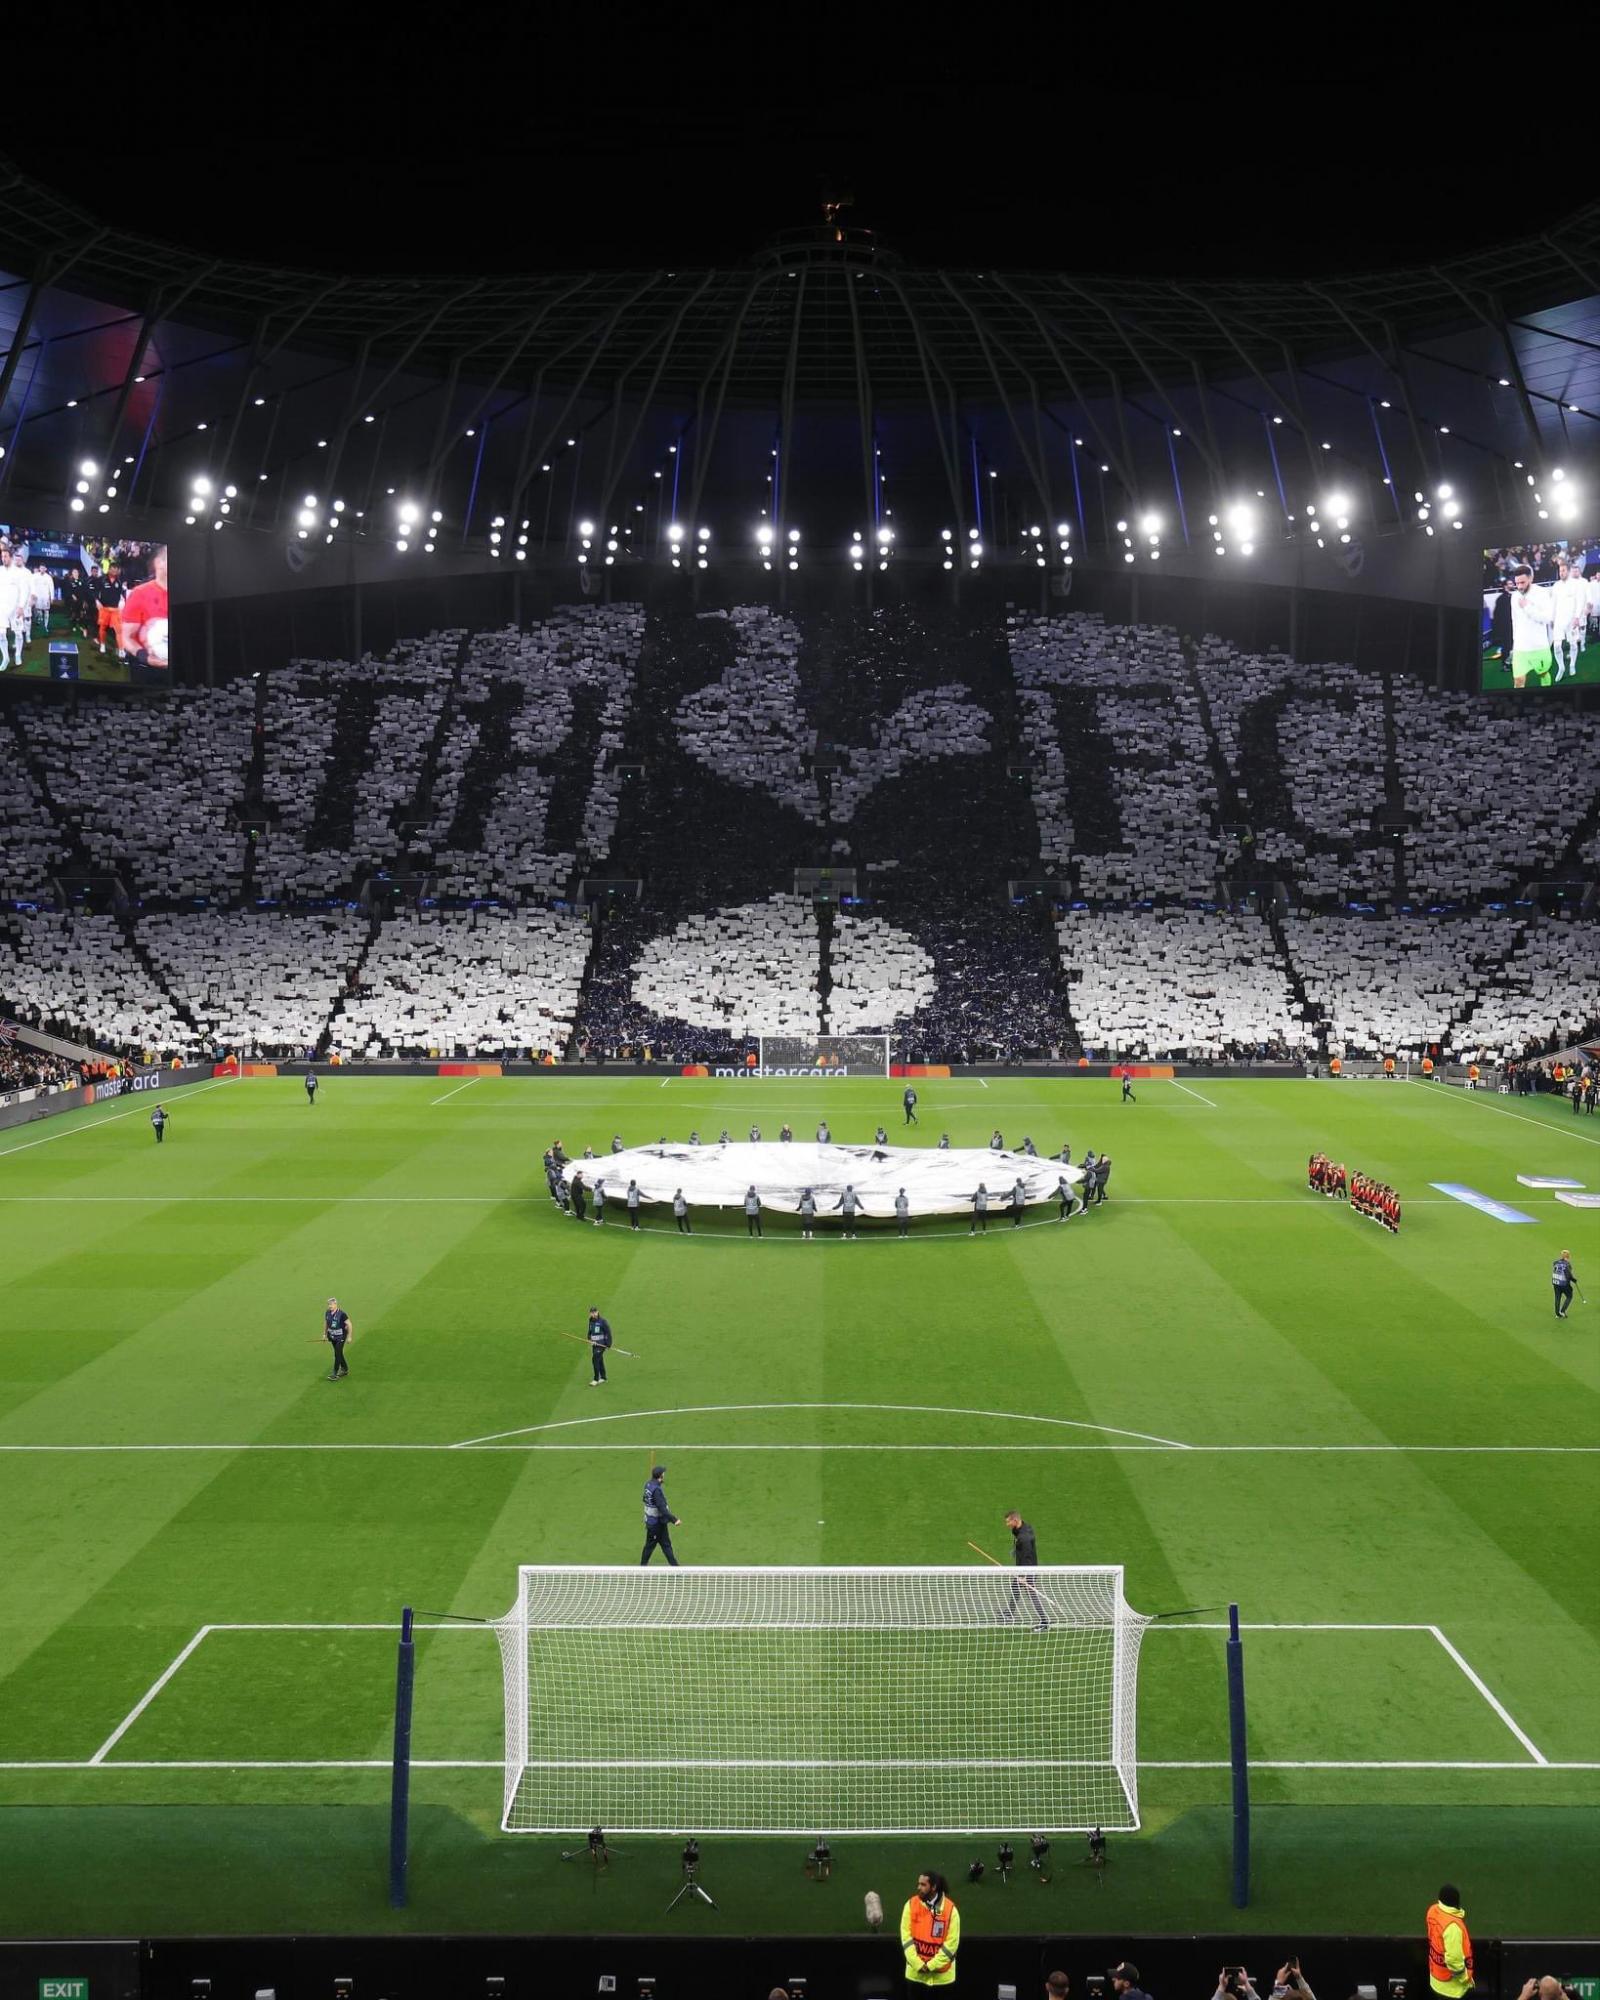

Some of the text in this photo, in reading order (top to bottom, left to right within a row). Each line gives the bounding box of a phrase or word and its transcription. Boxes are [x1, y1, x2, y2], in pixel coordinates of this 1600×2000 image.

[715, 1064, 848, 1078] mastercard
[96, 1071, 160, 1100] masterard
[43, 1982, 84, 1998] EXIT
